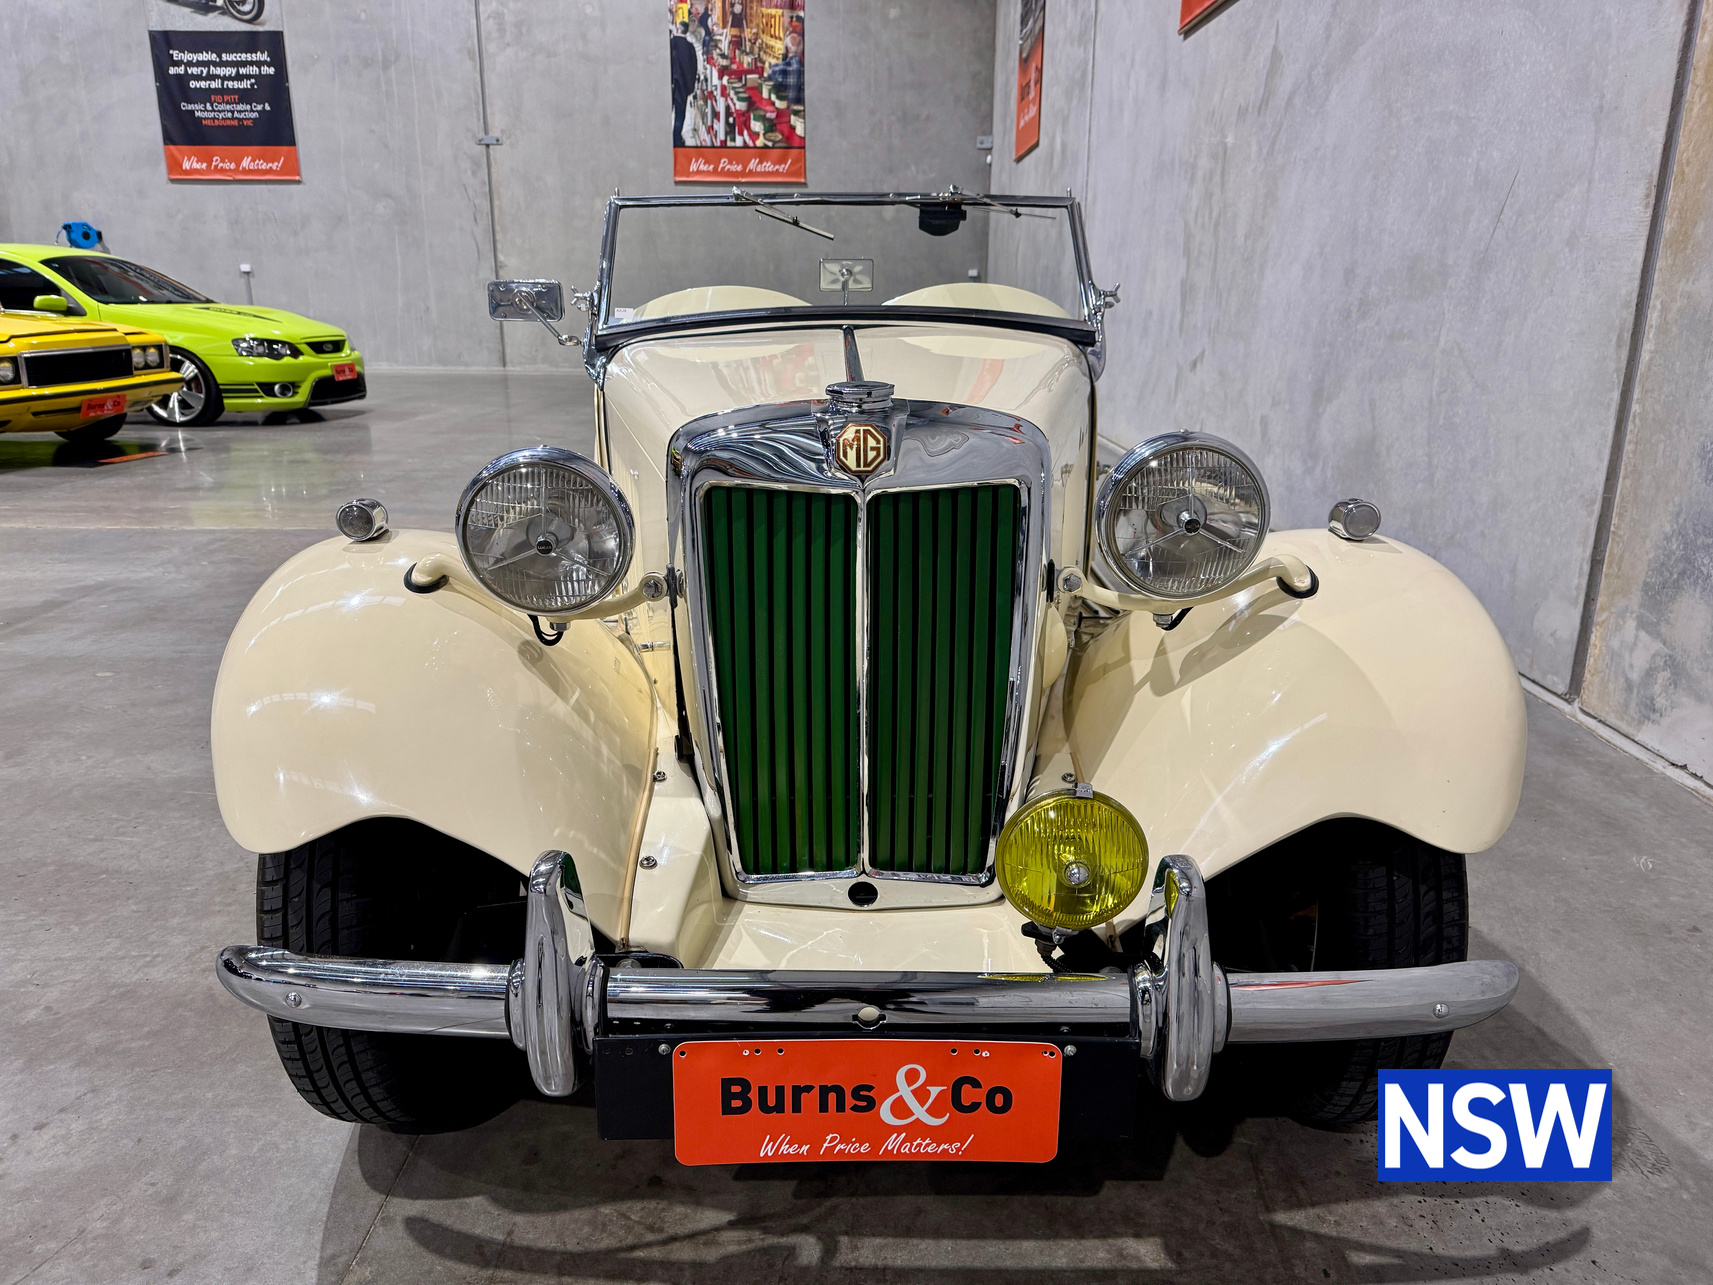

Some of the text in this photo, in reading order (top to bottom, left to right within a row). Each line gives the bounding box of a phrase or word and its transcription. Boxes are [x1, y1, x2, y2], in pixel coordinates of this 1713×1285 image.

[169, 49, 270, 63] "Enjoyable, successful,
[168, 64, 275, 77] and very happy with the
[189, 78, 222, 88] overall
[223, 94, 239, 102] PITT
[180, 101, 271, 111] Classic & Collectable Car &
[194, 110, 259, 120] Motorcycle Auction
[201, 118, 239, 126] MELBOURNE
[182, 155, 285, 171] When Price Matters!
[689, 157, 792, 173] When Price Matters!
[842, 428, 882, 469] MG
[759, 1132, 975, 1158] When Price Matters!
